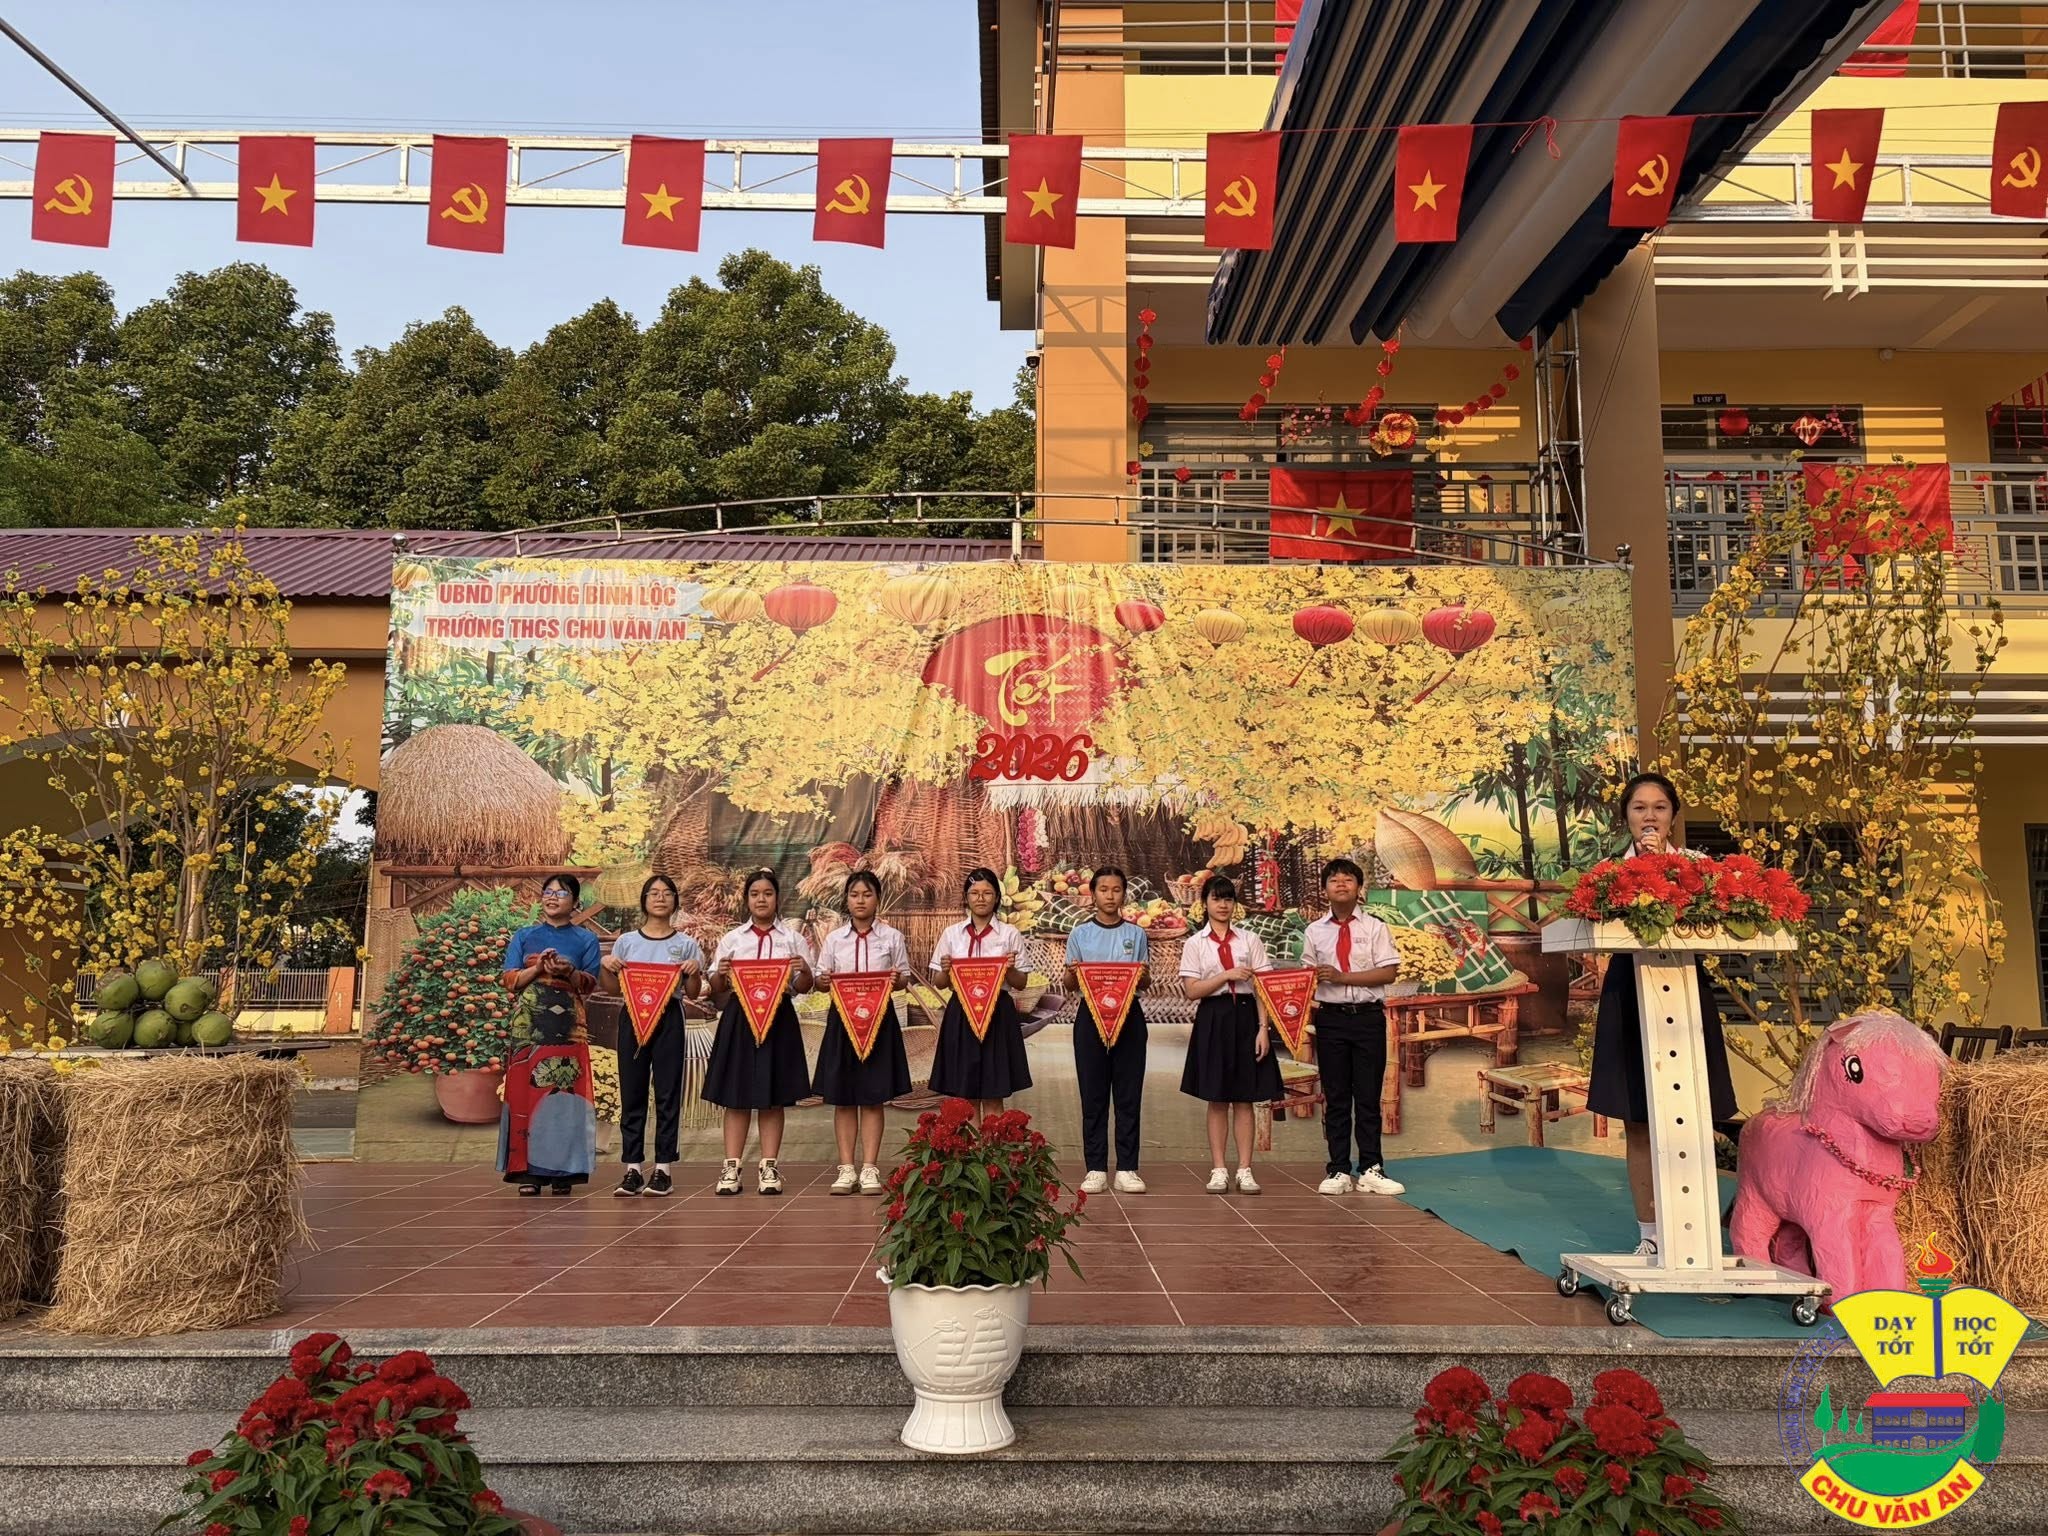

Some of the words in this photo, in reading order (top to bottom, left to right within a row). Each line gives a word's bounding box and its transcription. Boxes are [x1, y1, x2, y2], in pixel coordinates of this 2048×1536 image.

[439, 583, 493, 605] UBND
[497, 578, 580, 605] PHƯỜNG
[585, 581, 634, 606] BÌNH
[639, 581, 677, 611] LỘC
[426, 613, 505, 638] TRƯỜNG
[511, 617, 560, 639] THCS
[566, 618, 606, 639] CHU
[612, 614, 652, 640] VĂN
[657, 620, 687, 641] AN
[969, 733, 1093, 782] 2026
